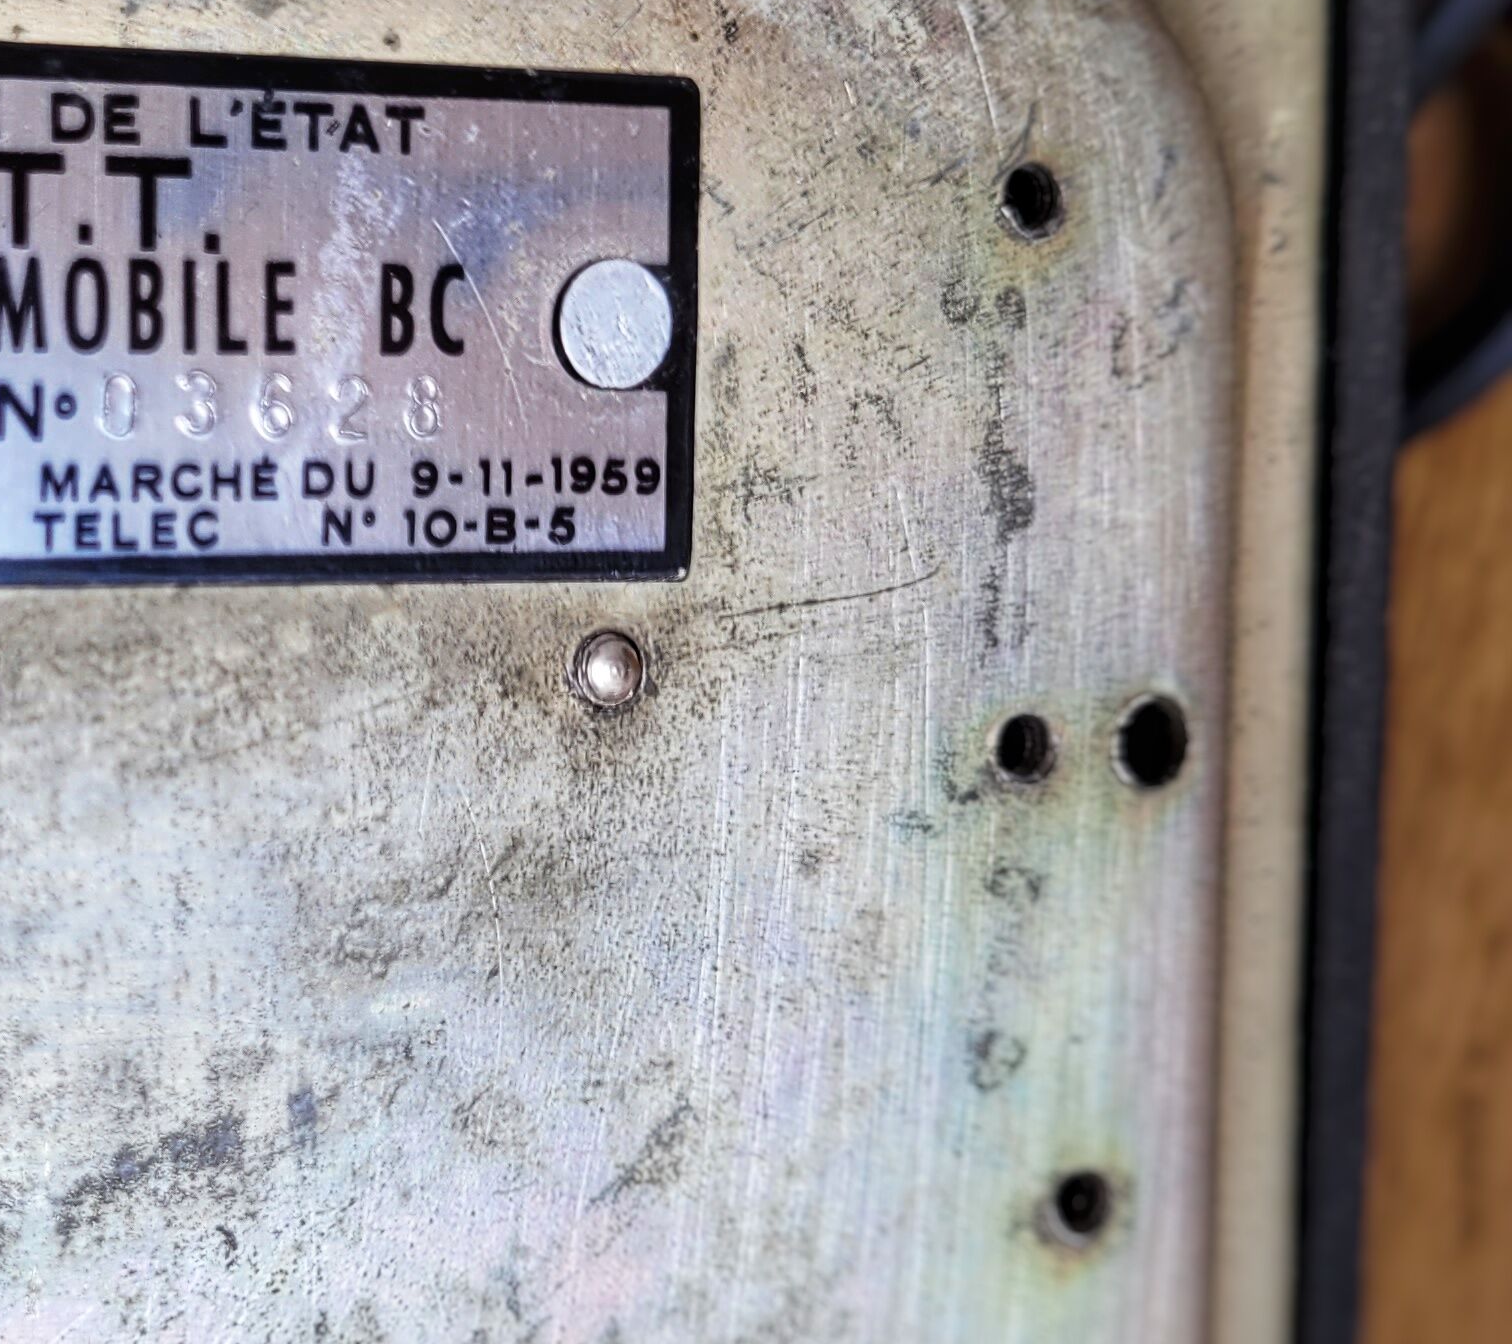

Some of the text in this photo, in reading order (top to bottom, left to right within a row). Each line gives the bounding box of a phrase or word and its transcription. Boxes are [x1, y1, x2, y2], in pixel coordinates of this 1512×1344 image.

[51, 92, 140, 145] DE
[189, 93, 426, 156] L'ÉTAT
[379, 264, 466, 356] BC
[302, 462, 375, 498] DU
[411, 456, 662, 498] 9-11-1959
[35, 511, 220, 551] TELEC
[405, 507, 577, 547] 10-B-5
